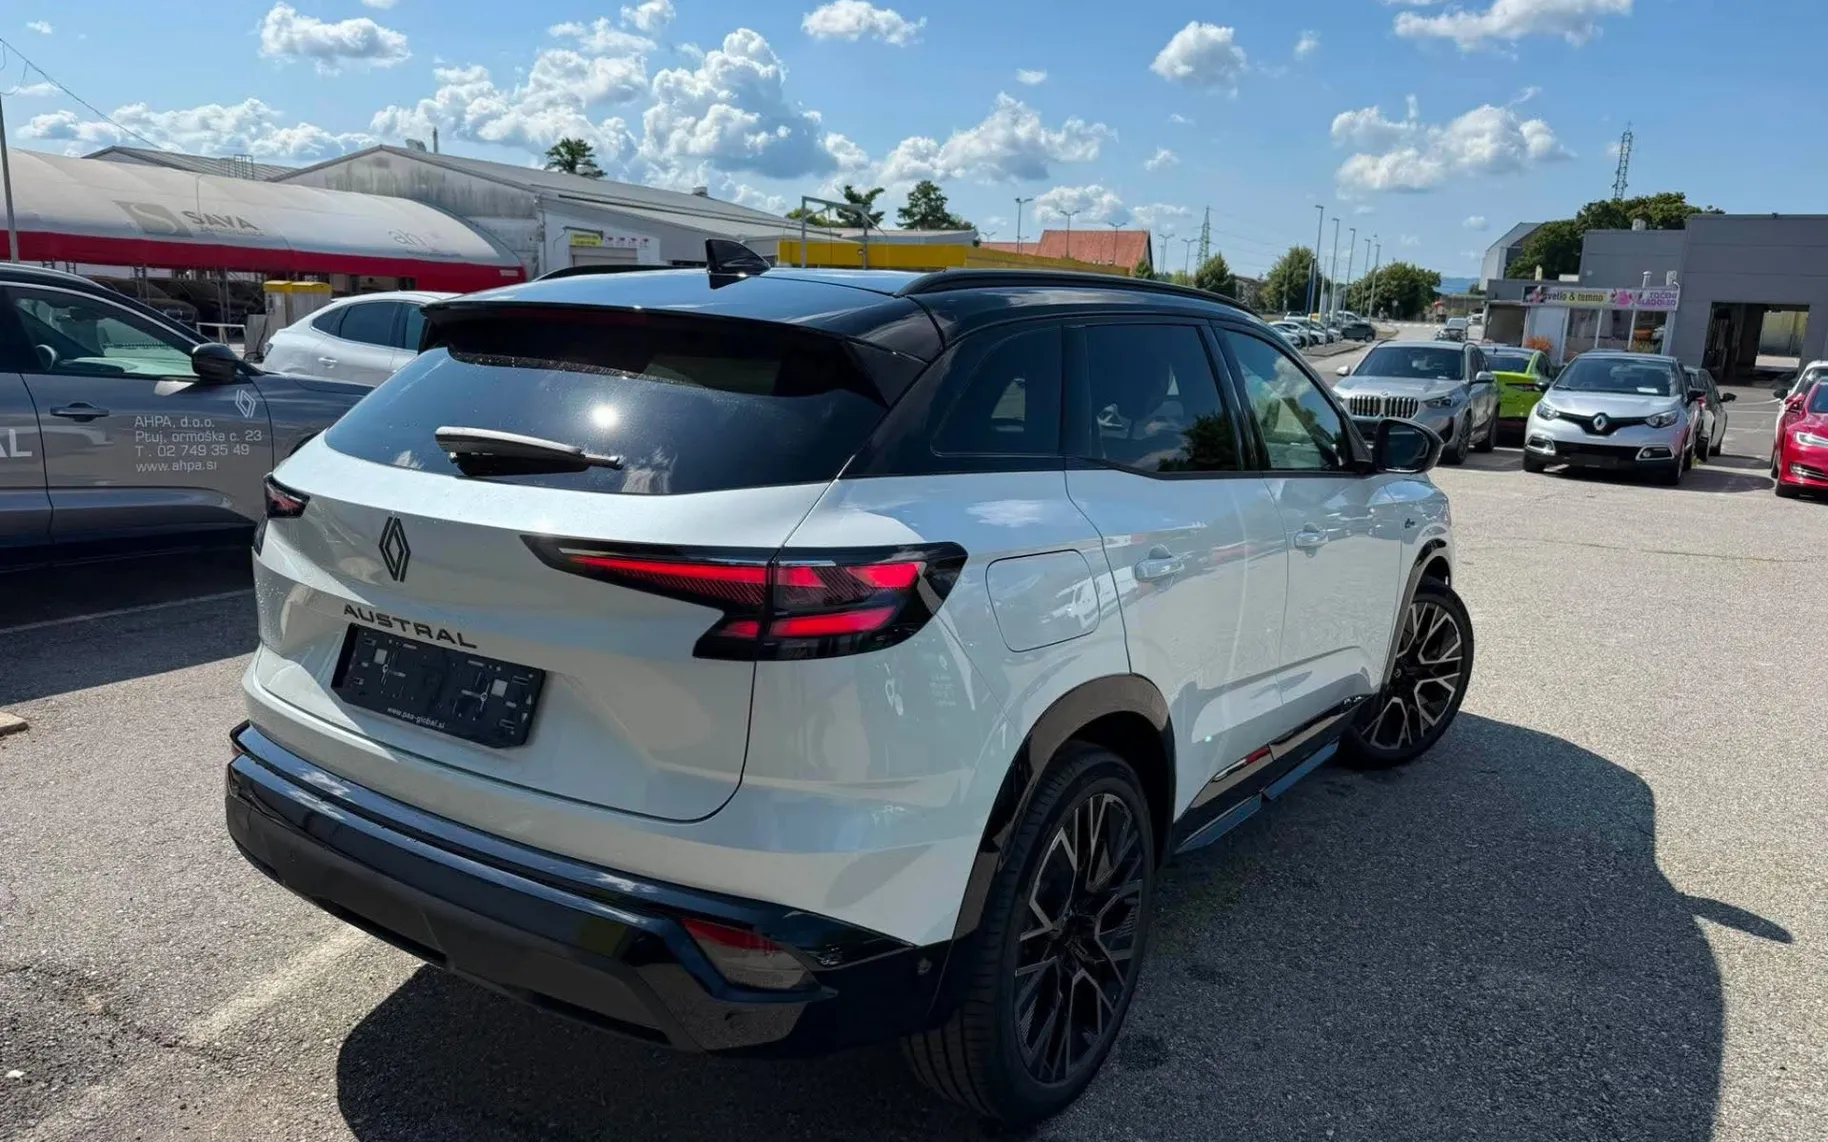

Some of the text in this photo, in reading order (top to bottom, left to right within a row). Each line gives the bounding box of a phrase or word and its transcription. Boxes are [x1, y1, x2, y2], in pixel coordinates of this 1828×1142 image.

[181, 210, 260, 231] SAVA
[1568, 291, 1575, 301] &
[134, 416, 215, 428] AHPA, d.o.o.
[172, 431, 225, 442] ormoška
[245, 430, 262, 441] 23
[157, 445, 176, 457] 02
[181, 445, 207, 456] 749
[211, 444, 228, 456] 35
[233, 444, 250, 455] 49
[136, 460, 217, 473] www.ahpa.si
[343, 604, 478, 649] AUSTRAL
